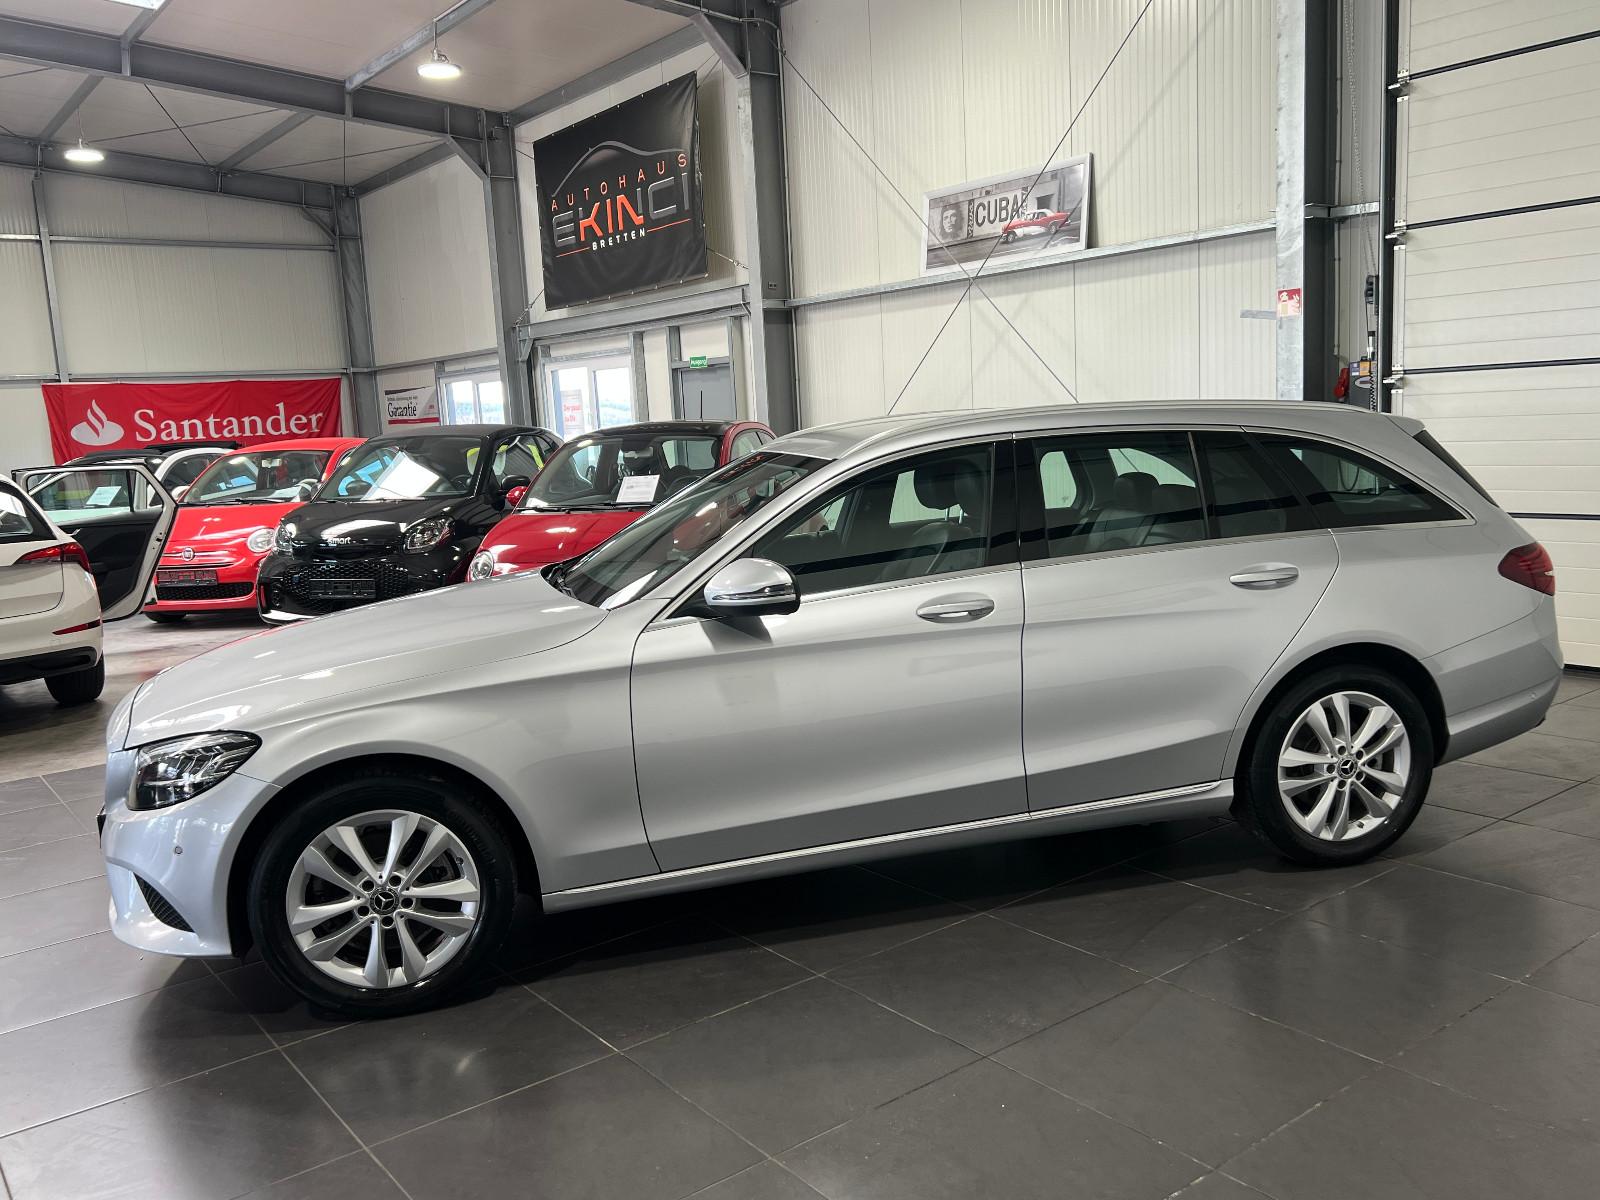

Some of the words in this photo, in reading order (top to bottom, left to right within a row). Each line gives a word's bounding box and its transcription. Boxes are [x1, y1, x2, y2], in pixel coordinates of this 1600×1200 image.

[551, 153, 688, 212] AUTOHAUS
[552, 172, 690, 248] EKINCI
[975, 194, 1021, 227] CUBA
[592, 227, 646, 251] BRETTEN
[135, 402, 323, 442] Santander
[327, 537, 351, 545] smart
